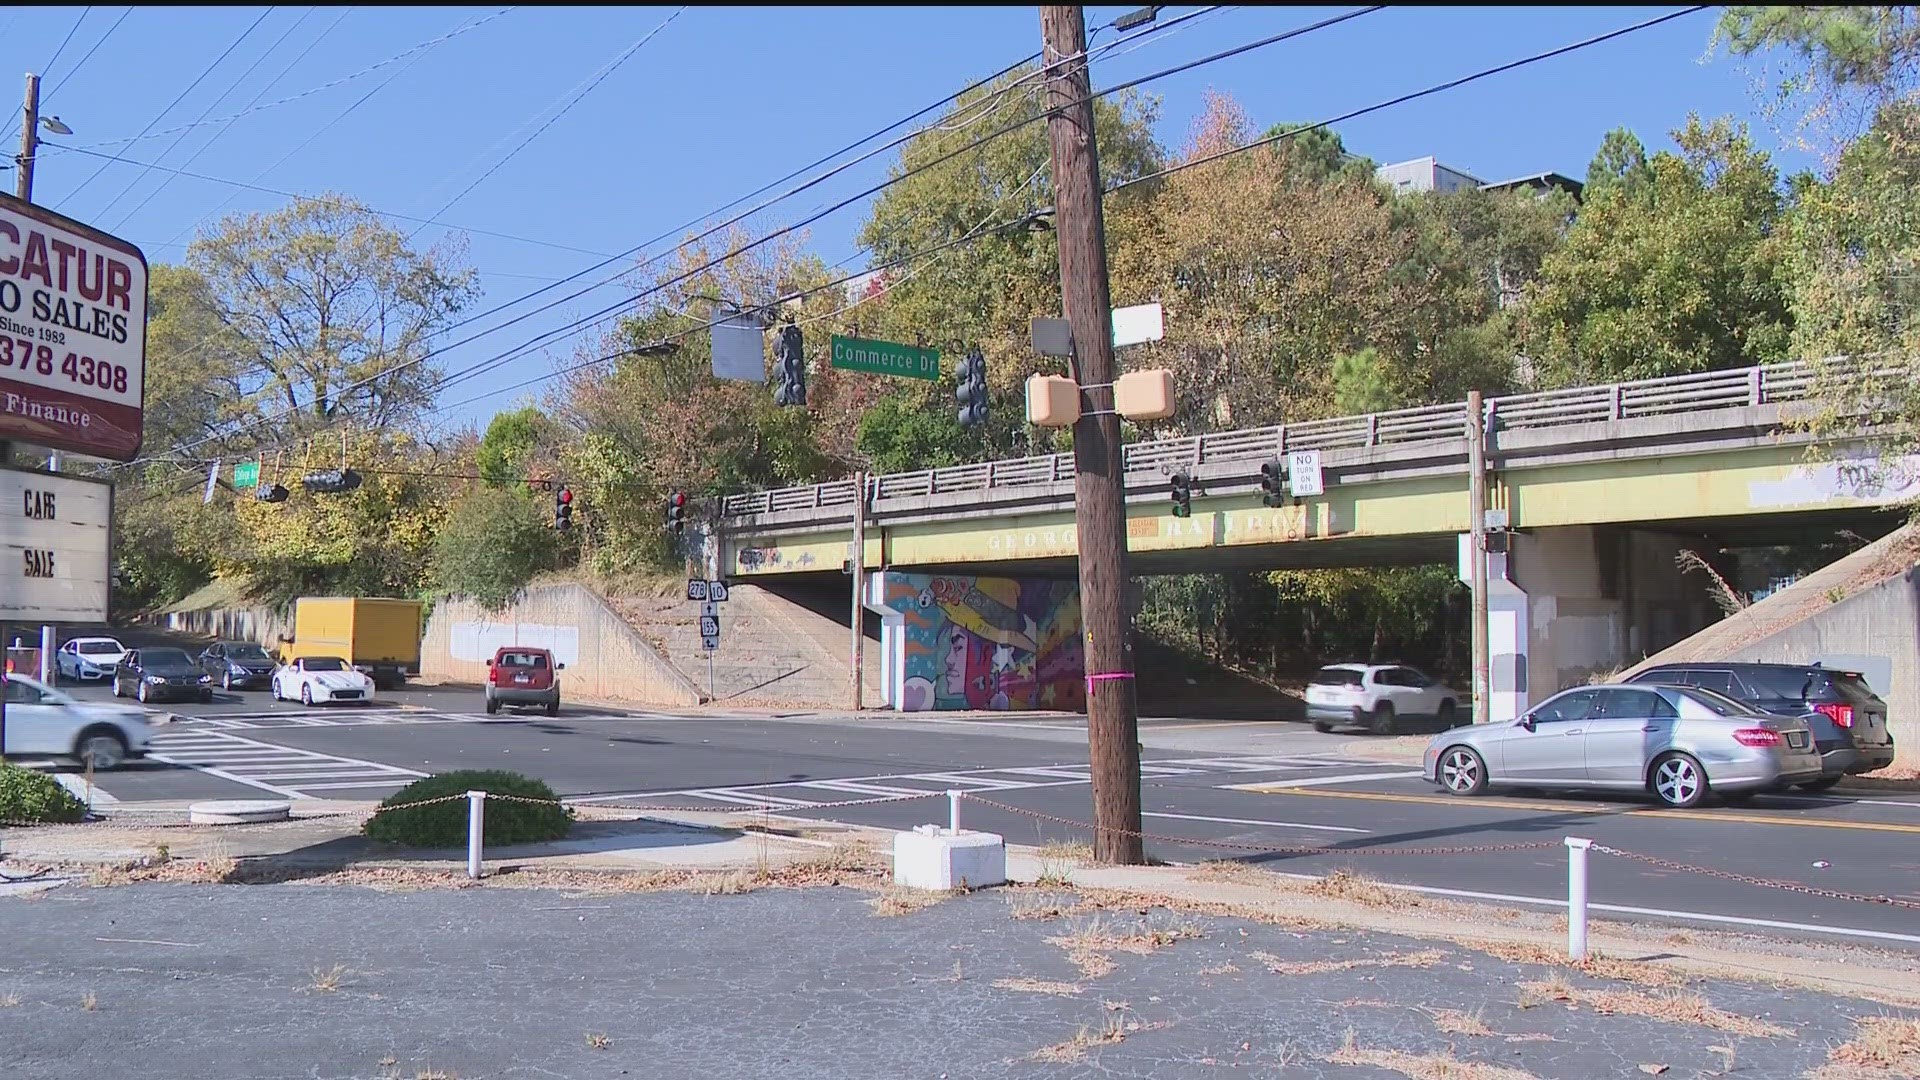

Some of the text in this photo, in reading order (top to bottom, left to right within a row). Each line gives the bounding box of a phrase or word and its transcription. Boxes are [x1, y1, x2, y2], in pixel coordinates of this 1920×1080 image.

[32, 289, 128, 344] SALES
[0, 316, 66, 345] Since 1982
[0, 334, 128, 394] 378 4308
[835, 343, 936, 372] Commerce Dr
[5, 392, 91, 427] Finance
[1296, 455, 1312, 465] NO
[1296, 466, 1314, 475] TURN
[1299, 484, 1313, 492] RED
[1300, 475, 1311, 483] ON
[988, 509, 1338, 551] GEORG RALROAD
[24, 549, 55, 578] SALE
[690, 583, 705, 596] 278
[712, 585, 723, 598] 10
[703, 620, 714, 634] 155
